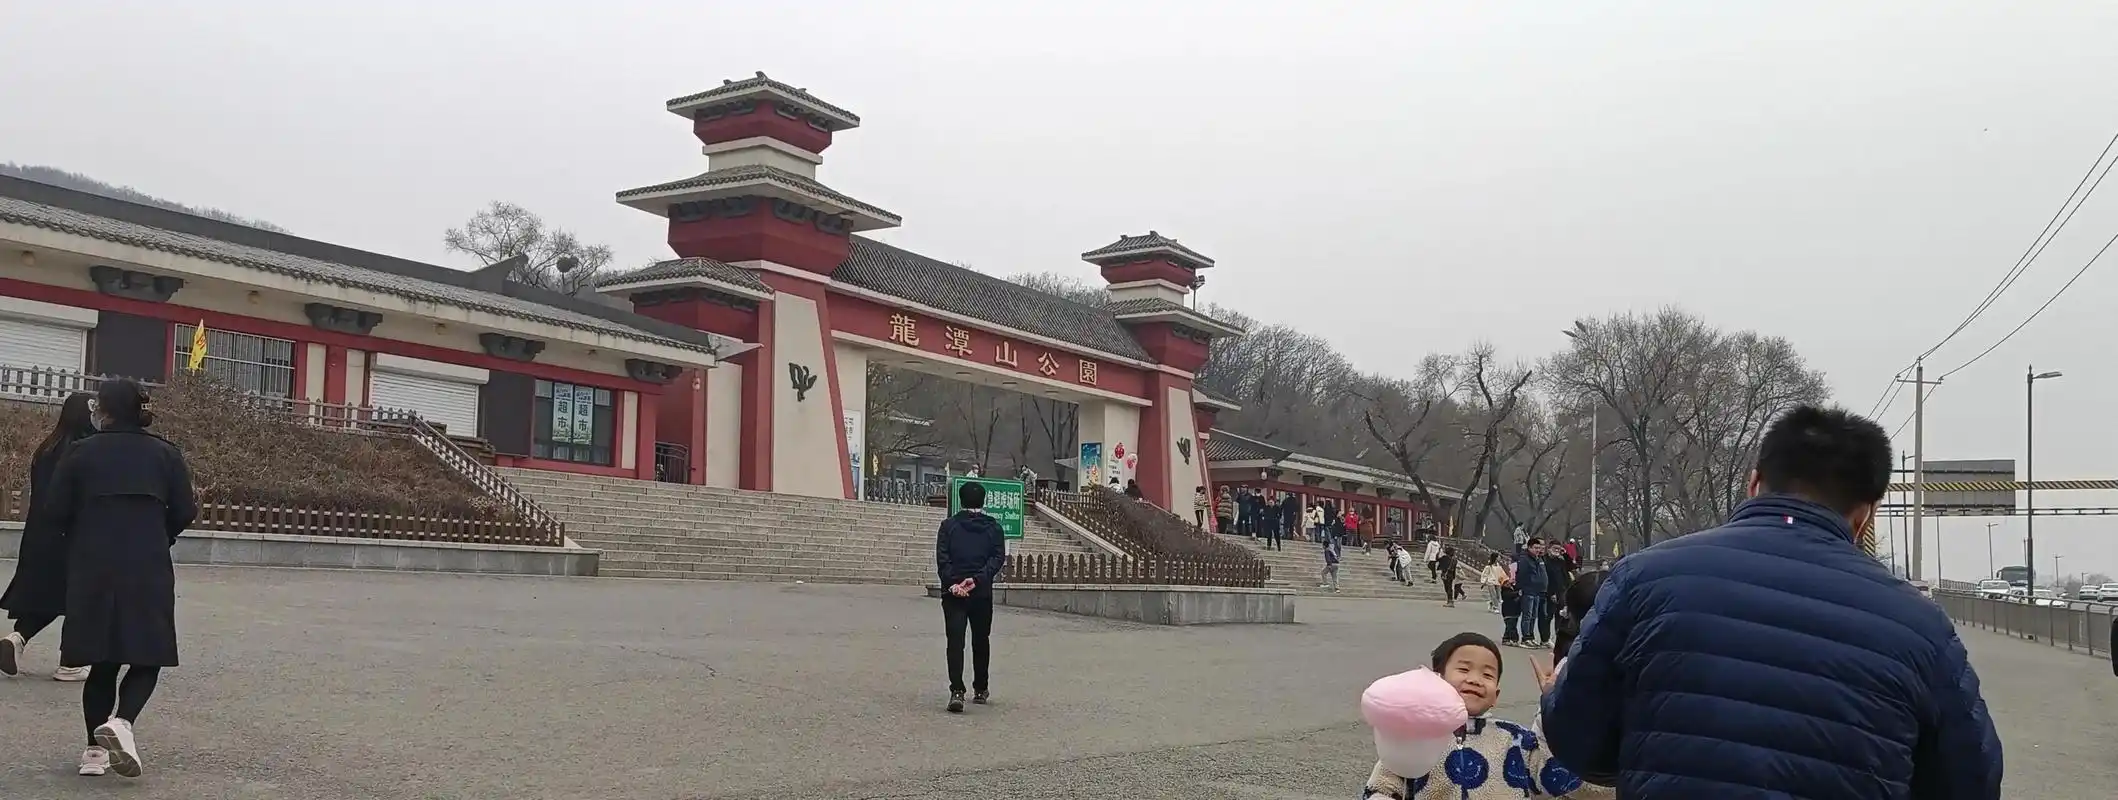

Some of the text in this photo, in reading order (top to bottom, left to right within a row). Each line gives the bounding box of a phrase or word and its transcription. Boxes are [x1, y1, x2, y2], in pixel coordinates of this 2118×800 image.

[889, 312, 1098, 386] 龍潭山公園
[558, 401, 568, 428] 超市
[578, 404, 588, 431] 超市
[983, 491, 1020, 510] 急避难场所
